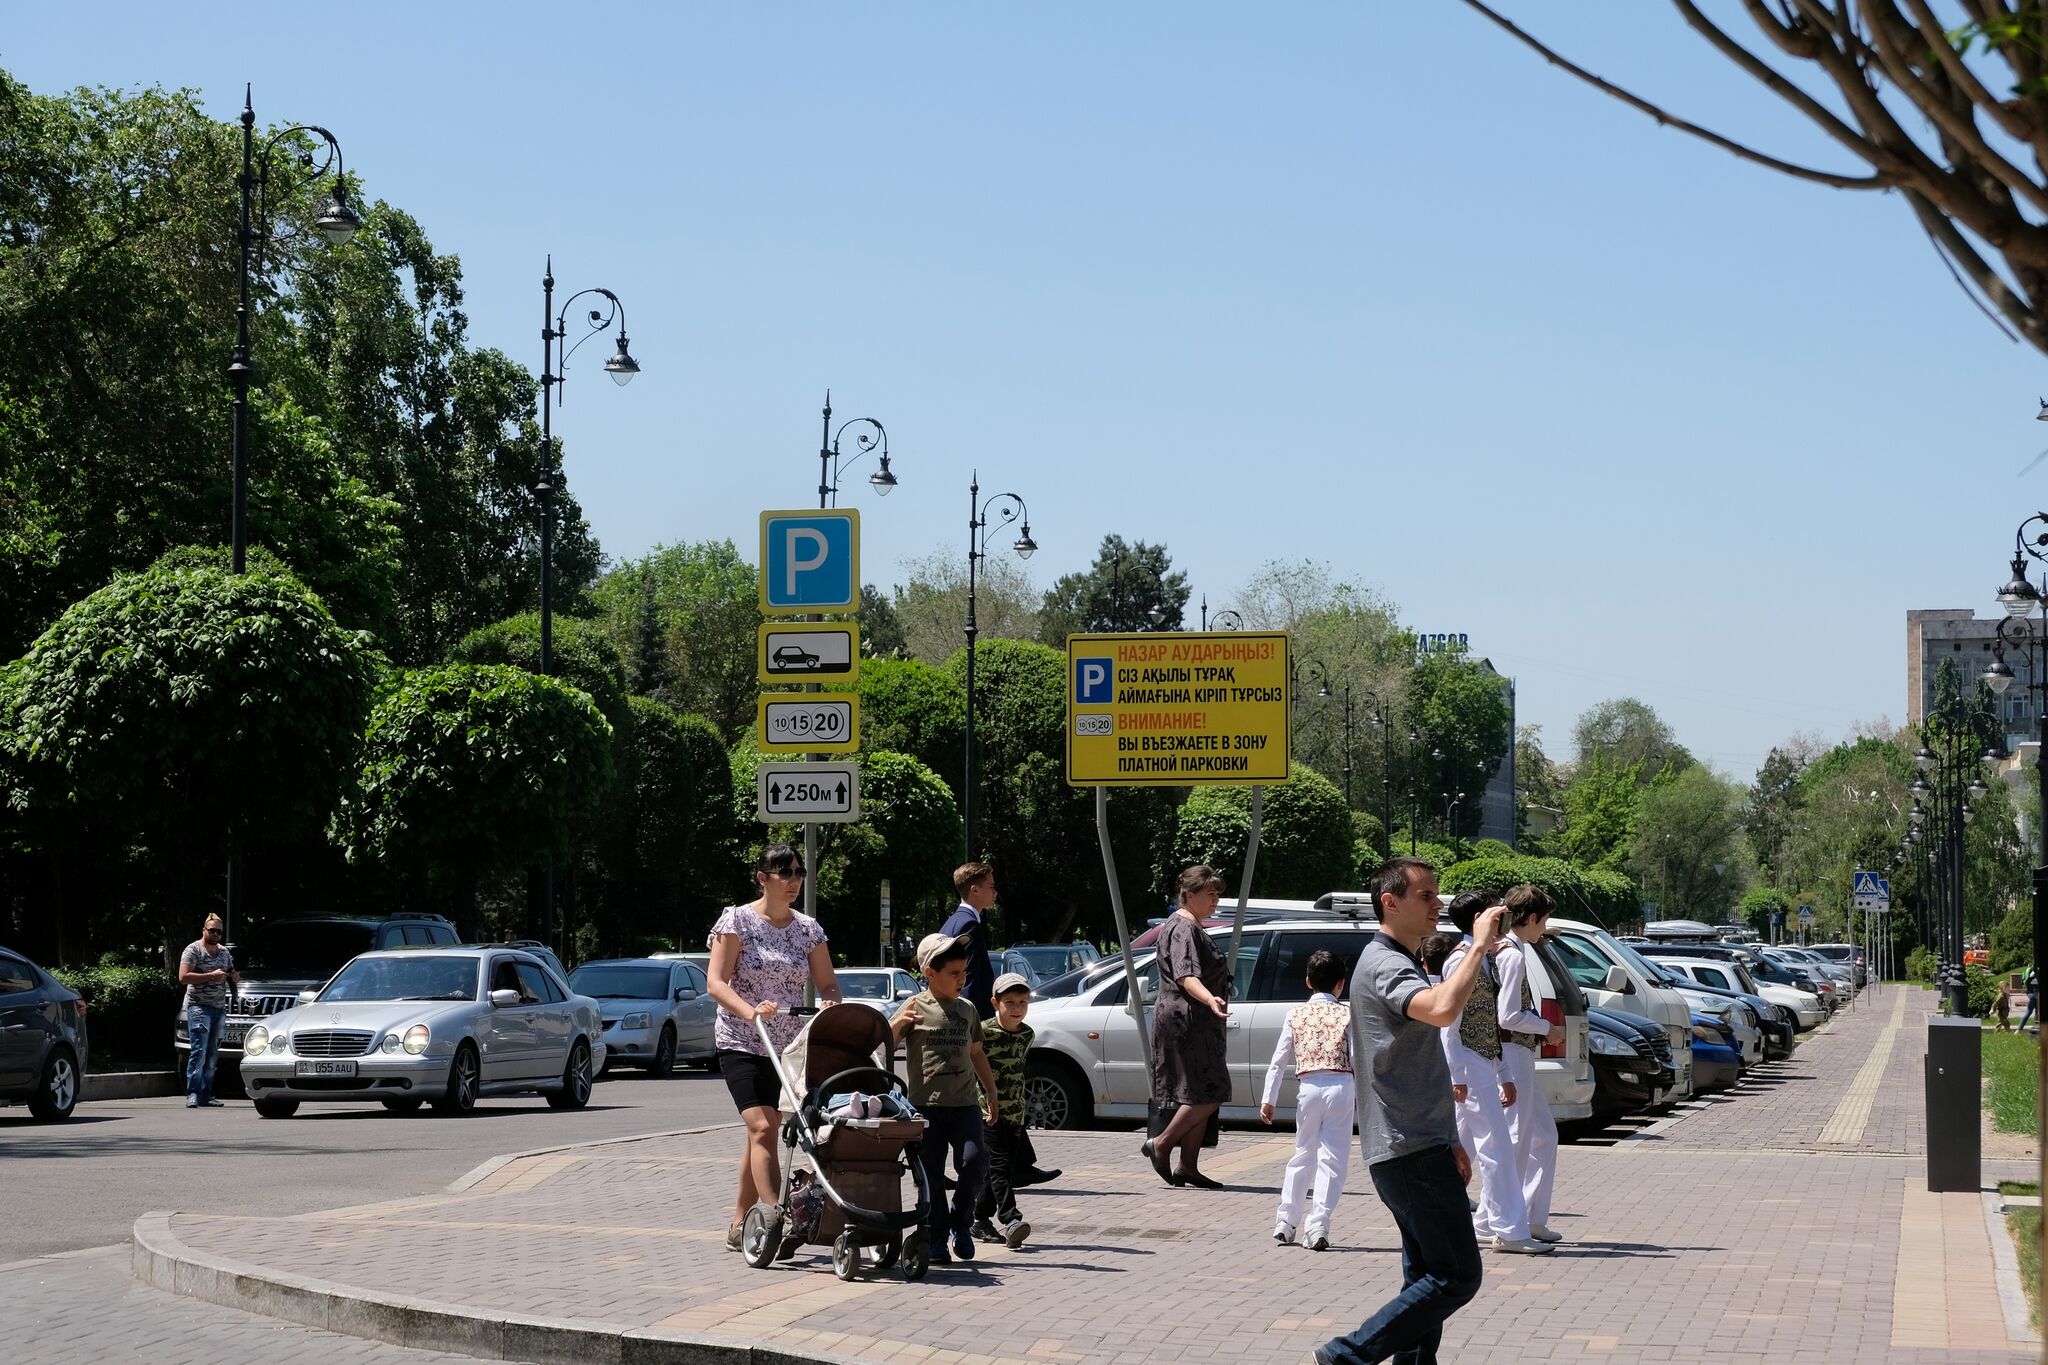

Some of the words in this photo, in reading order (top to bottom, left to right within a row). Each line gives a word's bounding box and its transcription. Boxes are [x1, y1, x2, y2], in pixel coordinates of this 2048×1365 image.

[786, 528, 828, 595] P
[1415, 633, 1468, 653] AZGOR
[1118, 644, 1167, 662] НАЗАР
[1172, 643, 1275, 664] АУДАРЫҢЫЗ!
[1083, 664, 1105, 698] P
[1118, 668, 1138, 683] СІЗ
[1142, 667, 1191, 686] АҚЫЛЫ
[1194, 667, 1236, 684] ТҰРАҚ
[1118, 686, 1191, 704] АЙМАҒЫНА
[1195, 688, 1228, 702] КІРІП
[1231, 687, 1283, 702] ТҰРСЫЗ
[1118, 712, 1207, 731] ВНИМАНИЕ!
[1118, 737, 1138, 751] ВЫ
[1142, 736, 1218, 751] ВЪЕЗЖАЕТЕ
[1222, 736, 1230, 750] В
[1234, 735, 1268, 750] ЗОНУ
[1118, 754, 1177, 772] ПЛАТНОЙ
[1181, 756, 1248, 772] ПАРКОВКИ
